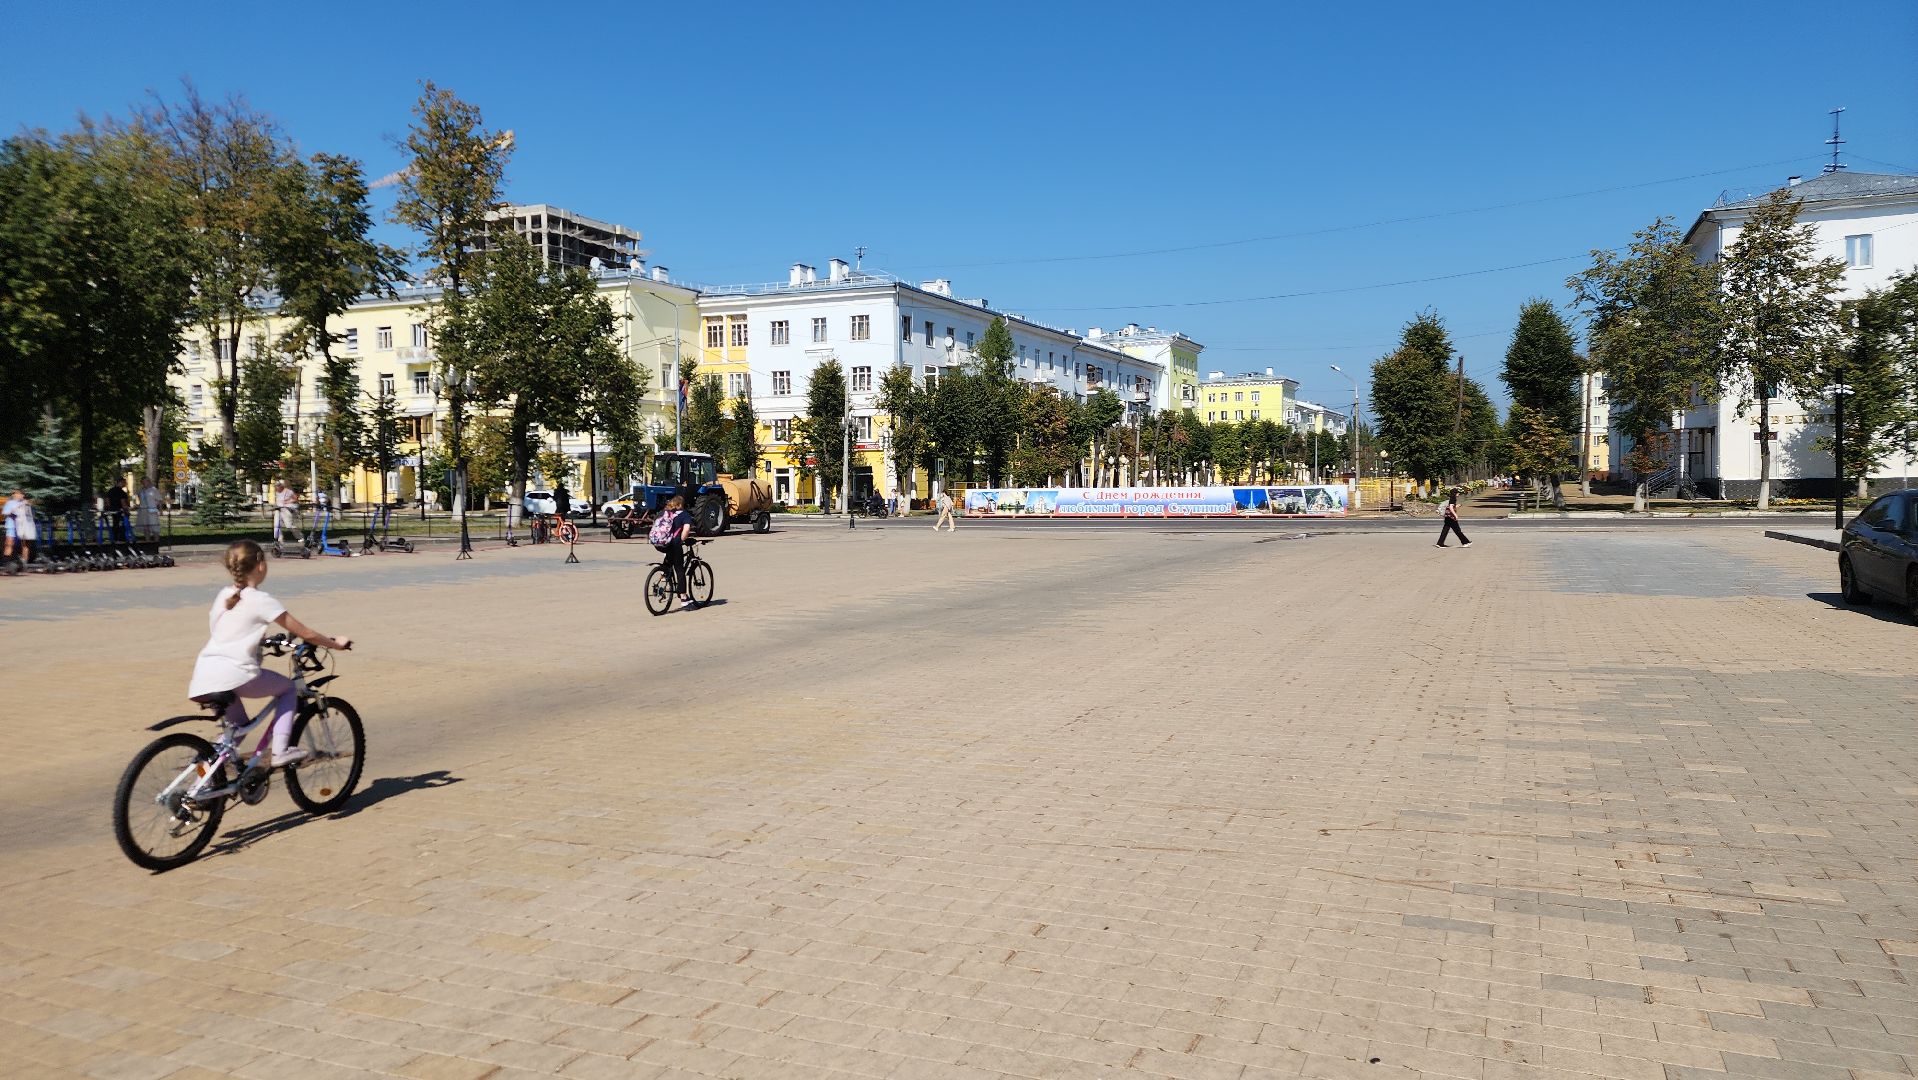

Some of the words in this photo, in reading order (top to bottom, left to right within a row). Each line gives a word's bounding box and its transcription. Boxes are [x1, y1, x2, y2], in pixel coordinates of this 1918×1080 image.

[1083, 492, 1090, 500] С
[1096, 491, 1128, 501] Днем
[1134, 492, 1205, 501] рождения,
[1059, 503, 1121, 513] любимый
[1123, 504, 1164, 515] город
[1168, 503, 1232, 515] Ступино!
